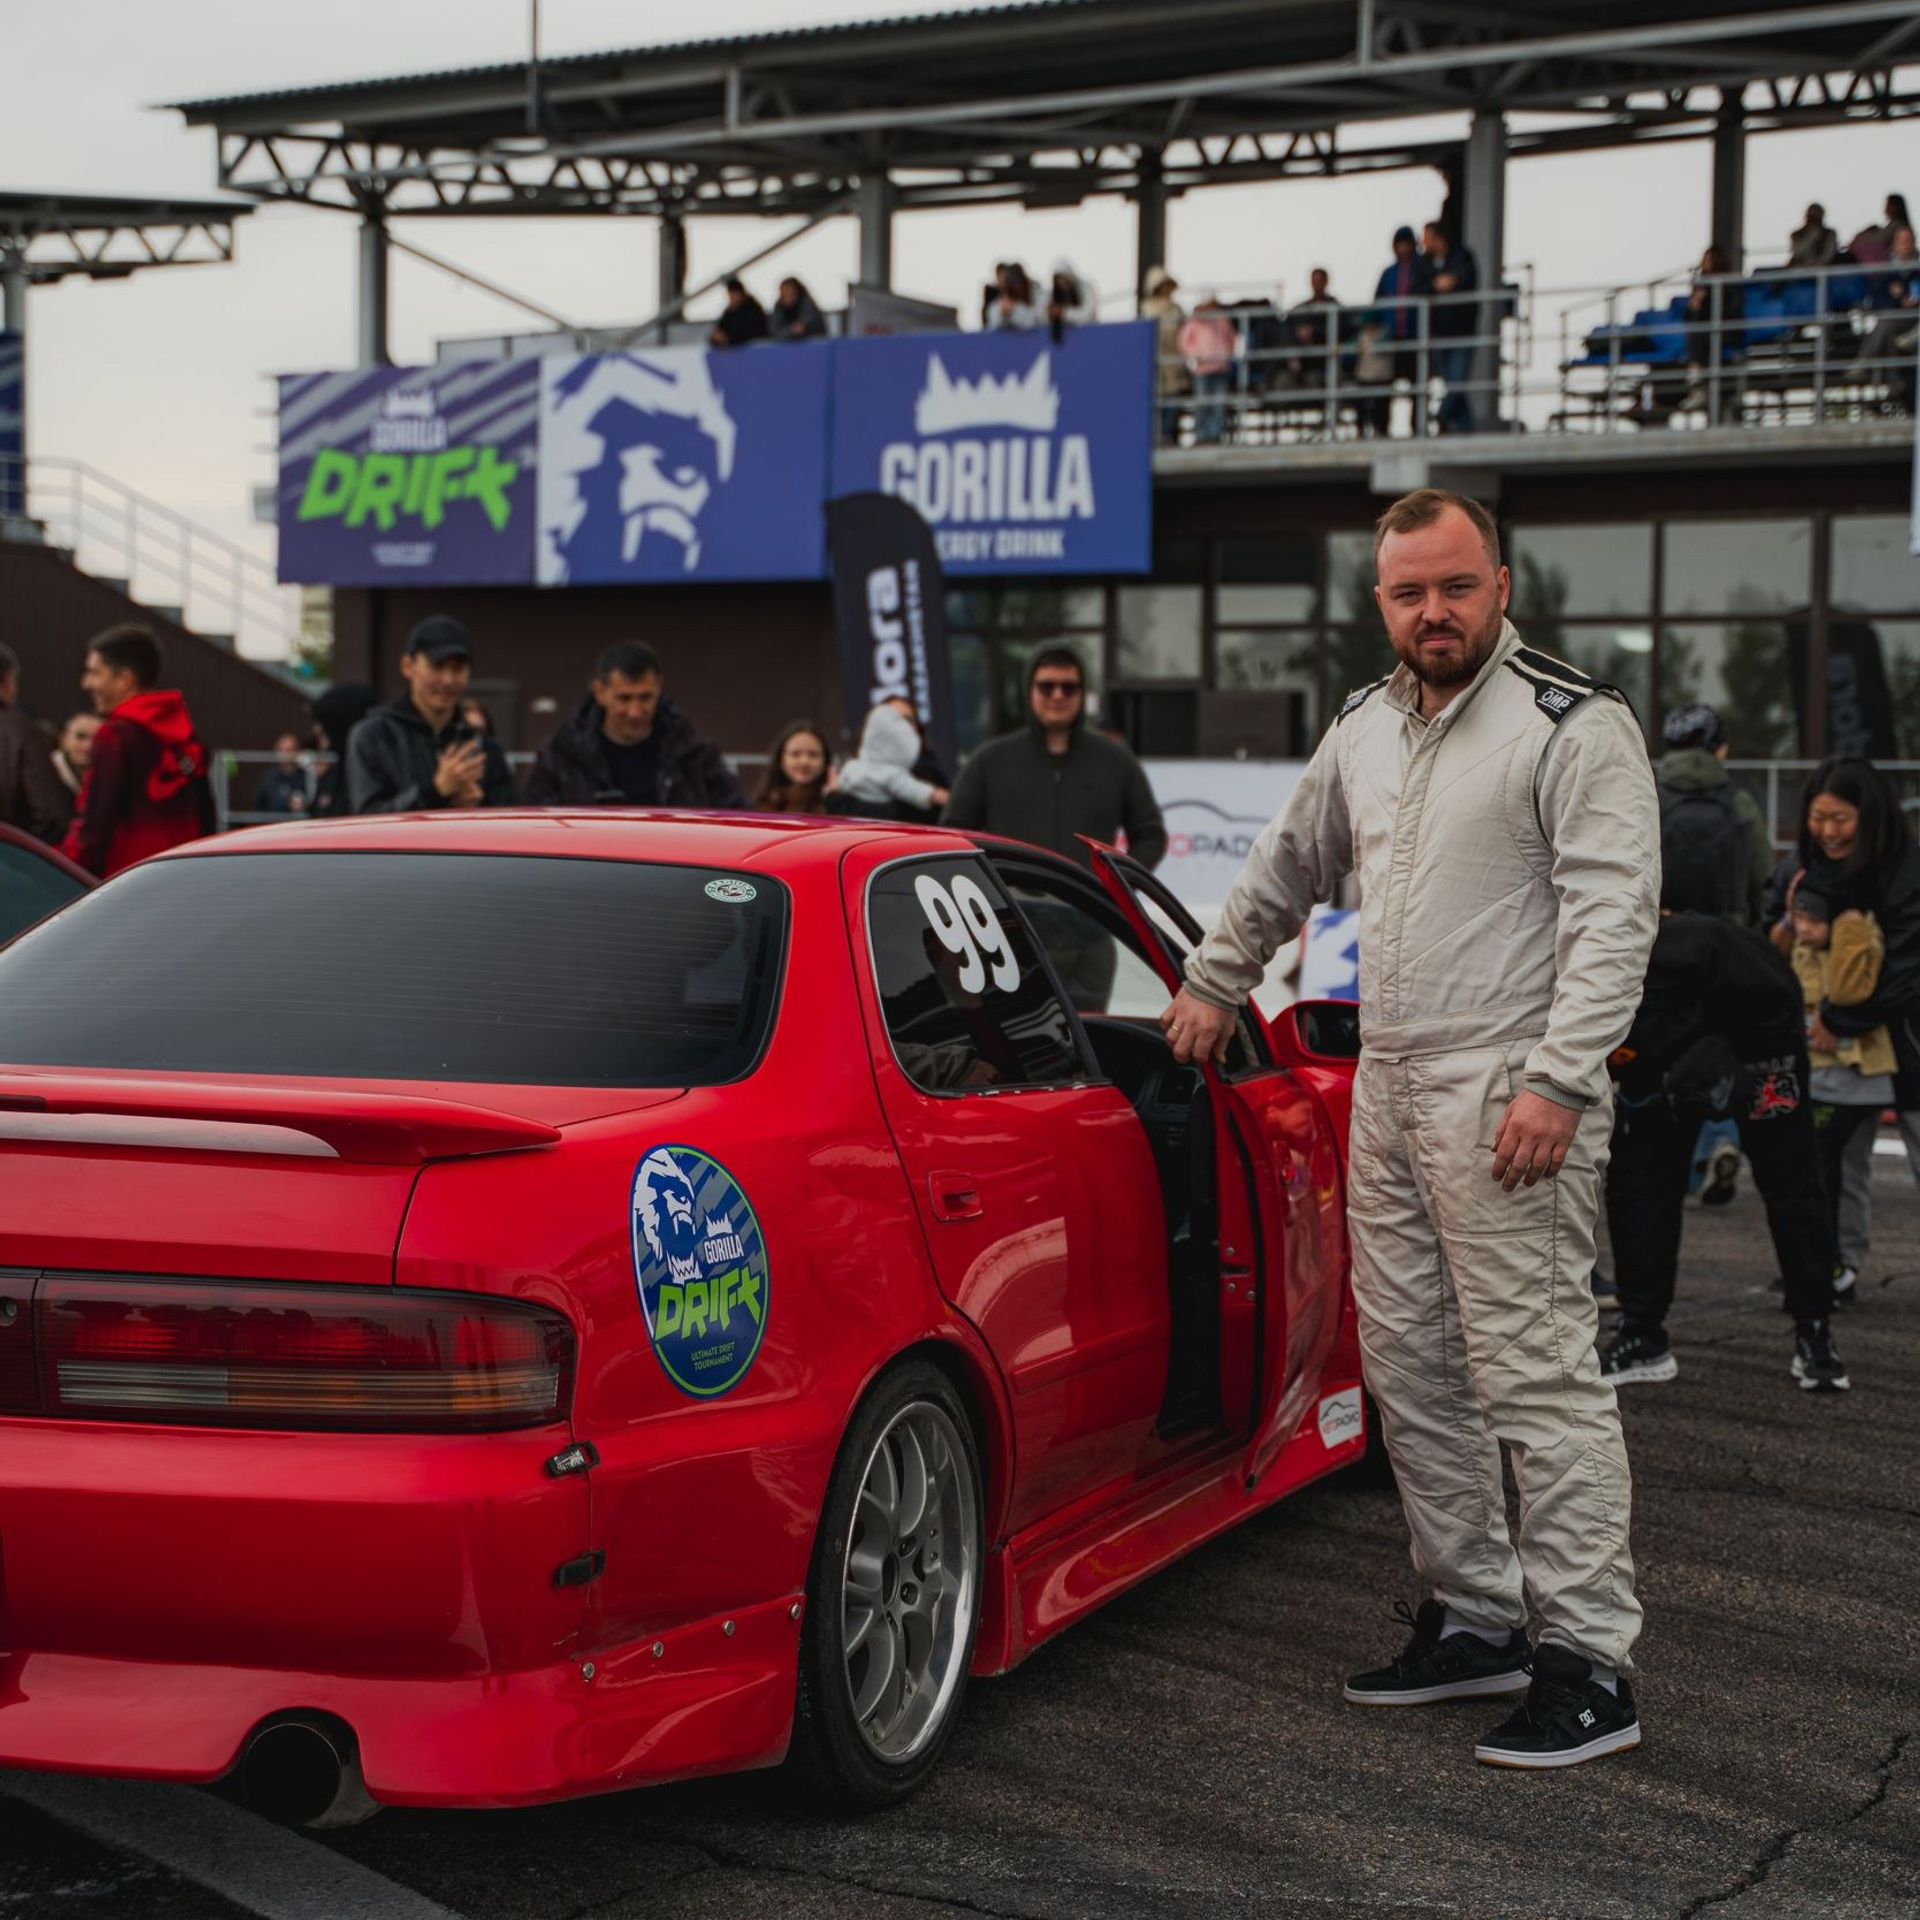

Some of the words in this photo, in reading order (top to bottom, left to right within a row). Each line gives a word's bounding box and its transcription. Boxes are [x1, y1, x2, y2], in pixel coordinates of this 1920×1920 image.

[297, 444, 519, 532] DRIFT
[880, 434, 1096, 523] GORILLA
[995, 528, 1065, 560] DRINK
[1541, 690, 1571, 709] OMP
[914, 874, 1021, 994] 99
[704, 1235, 745, 1264] GORILLA
[654, 1266, 761, 1342] DRIFT
[691, 1346, 718, 1361] ULTIMATE
[718, 1341, 736, 1355] DRIFT
[694, 1352, 734, 1370] TOURNAMENT
